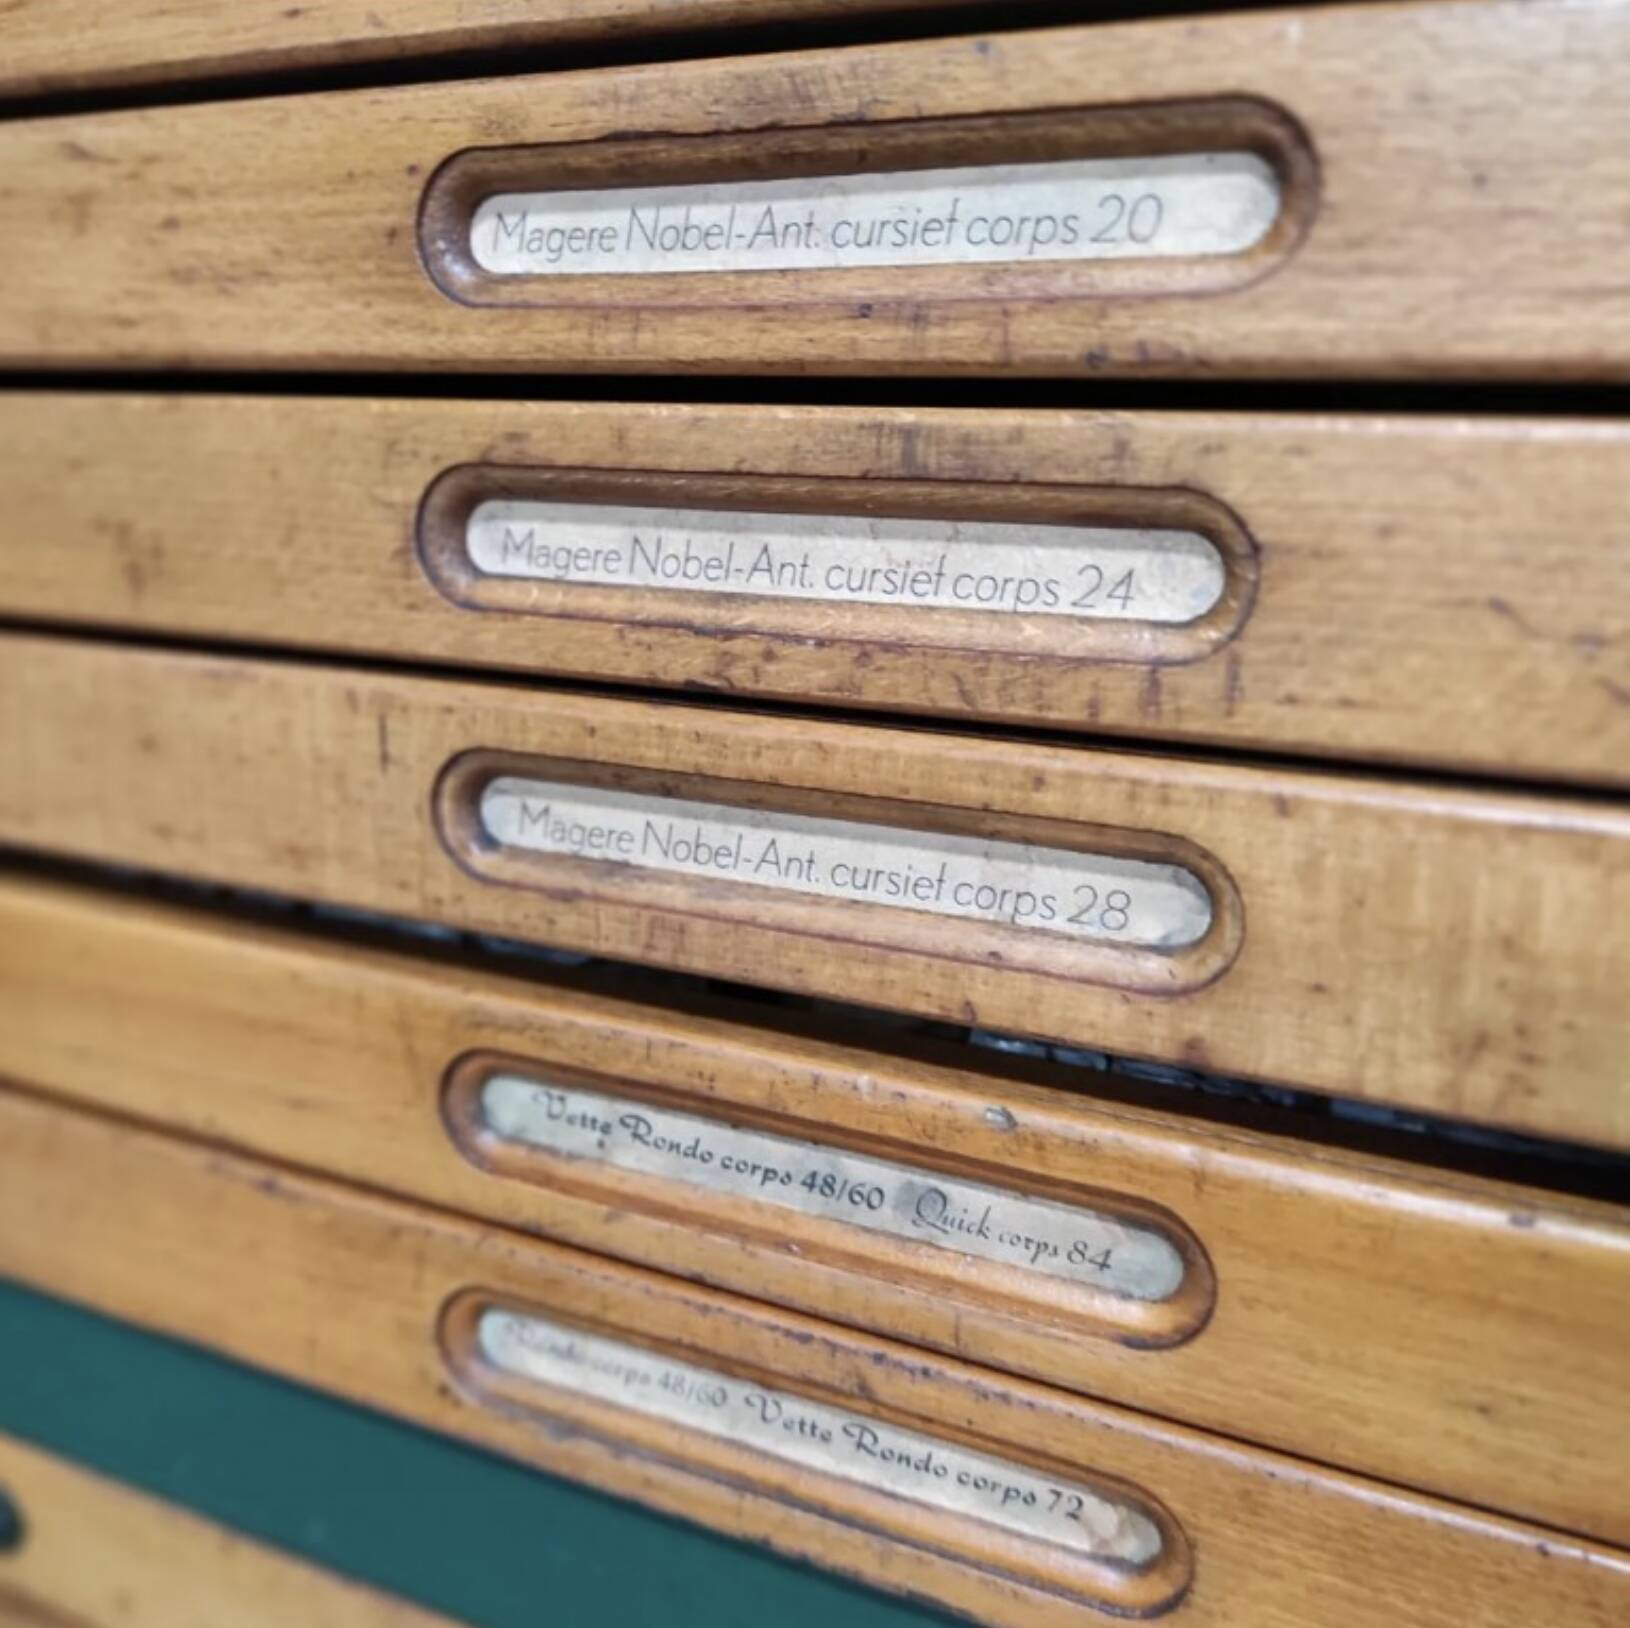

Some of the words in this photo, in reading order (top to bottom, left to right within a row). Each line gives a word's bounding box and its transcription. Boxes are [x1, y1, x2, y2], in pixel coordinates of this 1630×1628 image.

[493, 210, 619, 263] Magere
[625, 205, 820, 250] Nobel-Ant.
[831, 198, 960, 249] cursief
[964, 213, 1079, 255] corps
[1090, 193, 1163, 244] 20
[502, 526, 623, 578] Magere
[628, 535, 815, 588] Nobel-Ant.
[824, 554, 946, 596] cursief
[952, 572, 1061, 612] corps
[1071, 564, 1136, 610] 24
[517, 801, 635, 853] Magere
[641, 820, 820, 883] Nobel-Ant.
[830, 862, 947, 901] cursief
[953, 881, 1057, 924] corps
[1067, 885, 1132, 931] 28
[530, 1090, 612, 1136] Vette
[618, 1113, 713, 1164] Rondo
[719, 1153, 792, 1186] corps
[800, 1169, 885, 1211] 48/60
[911, 1187, 990, 1240] Quick
[998, 1230, 1059, 1264] corps
[1066, 1240, 1112, 1271] 84
[657, 1370, 727, 1407] 48/60
[744, 1393, 832, 1443] Vette
[842, 1422, 948, 1479] Rondo
[955, 1467, 1037, 1507] corps
[1047, 1488, 1084, 1521] 72
